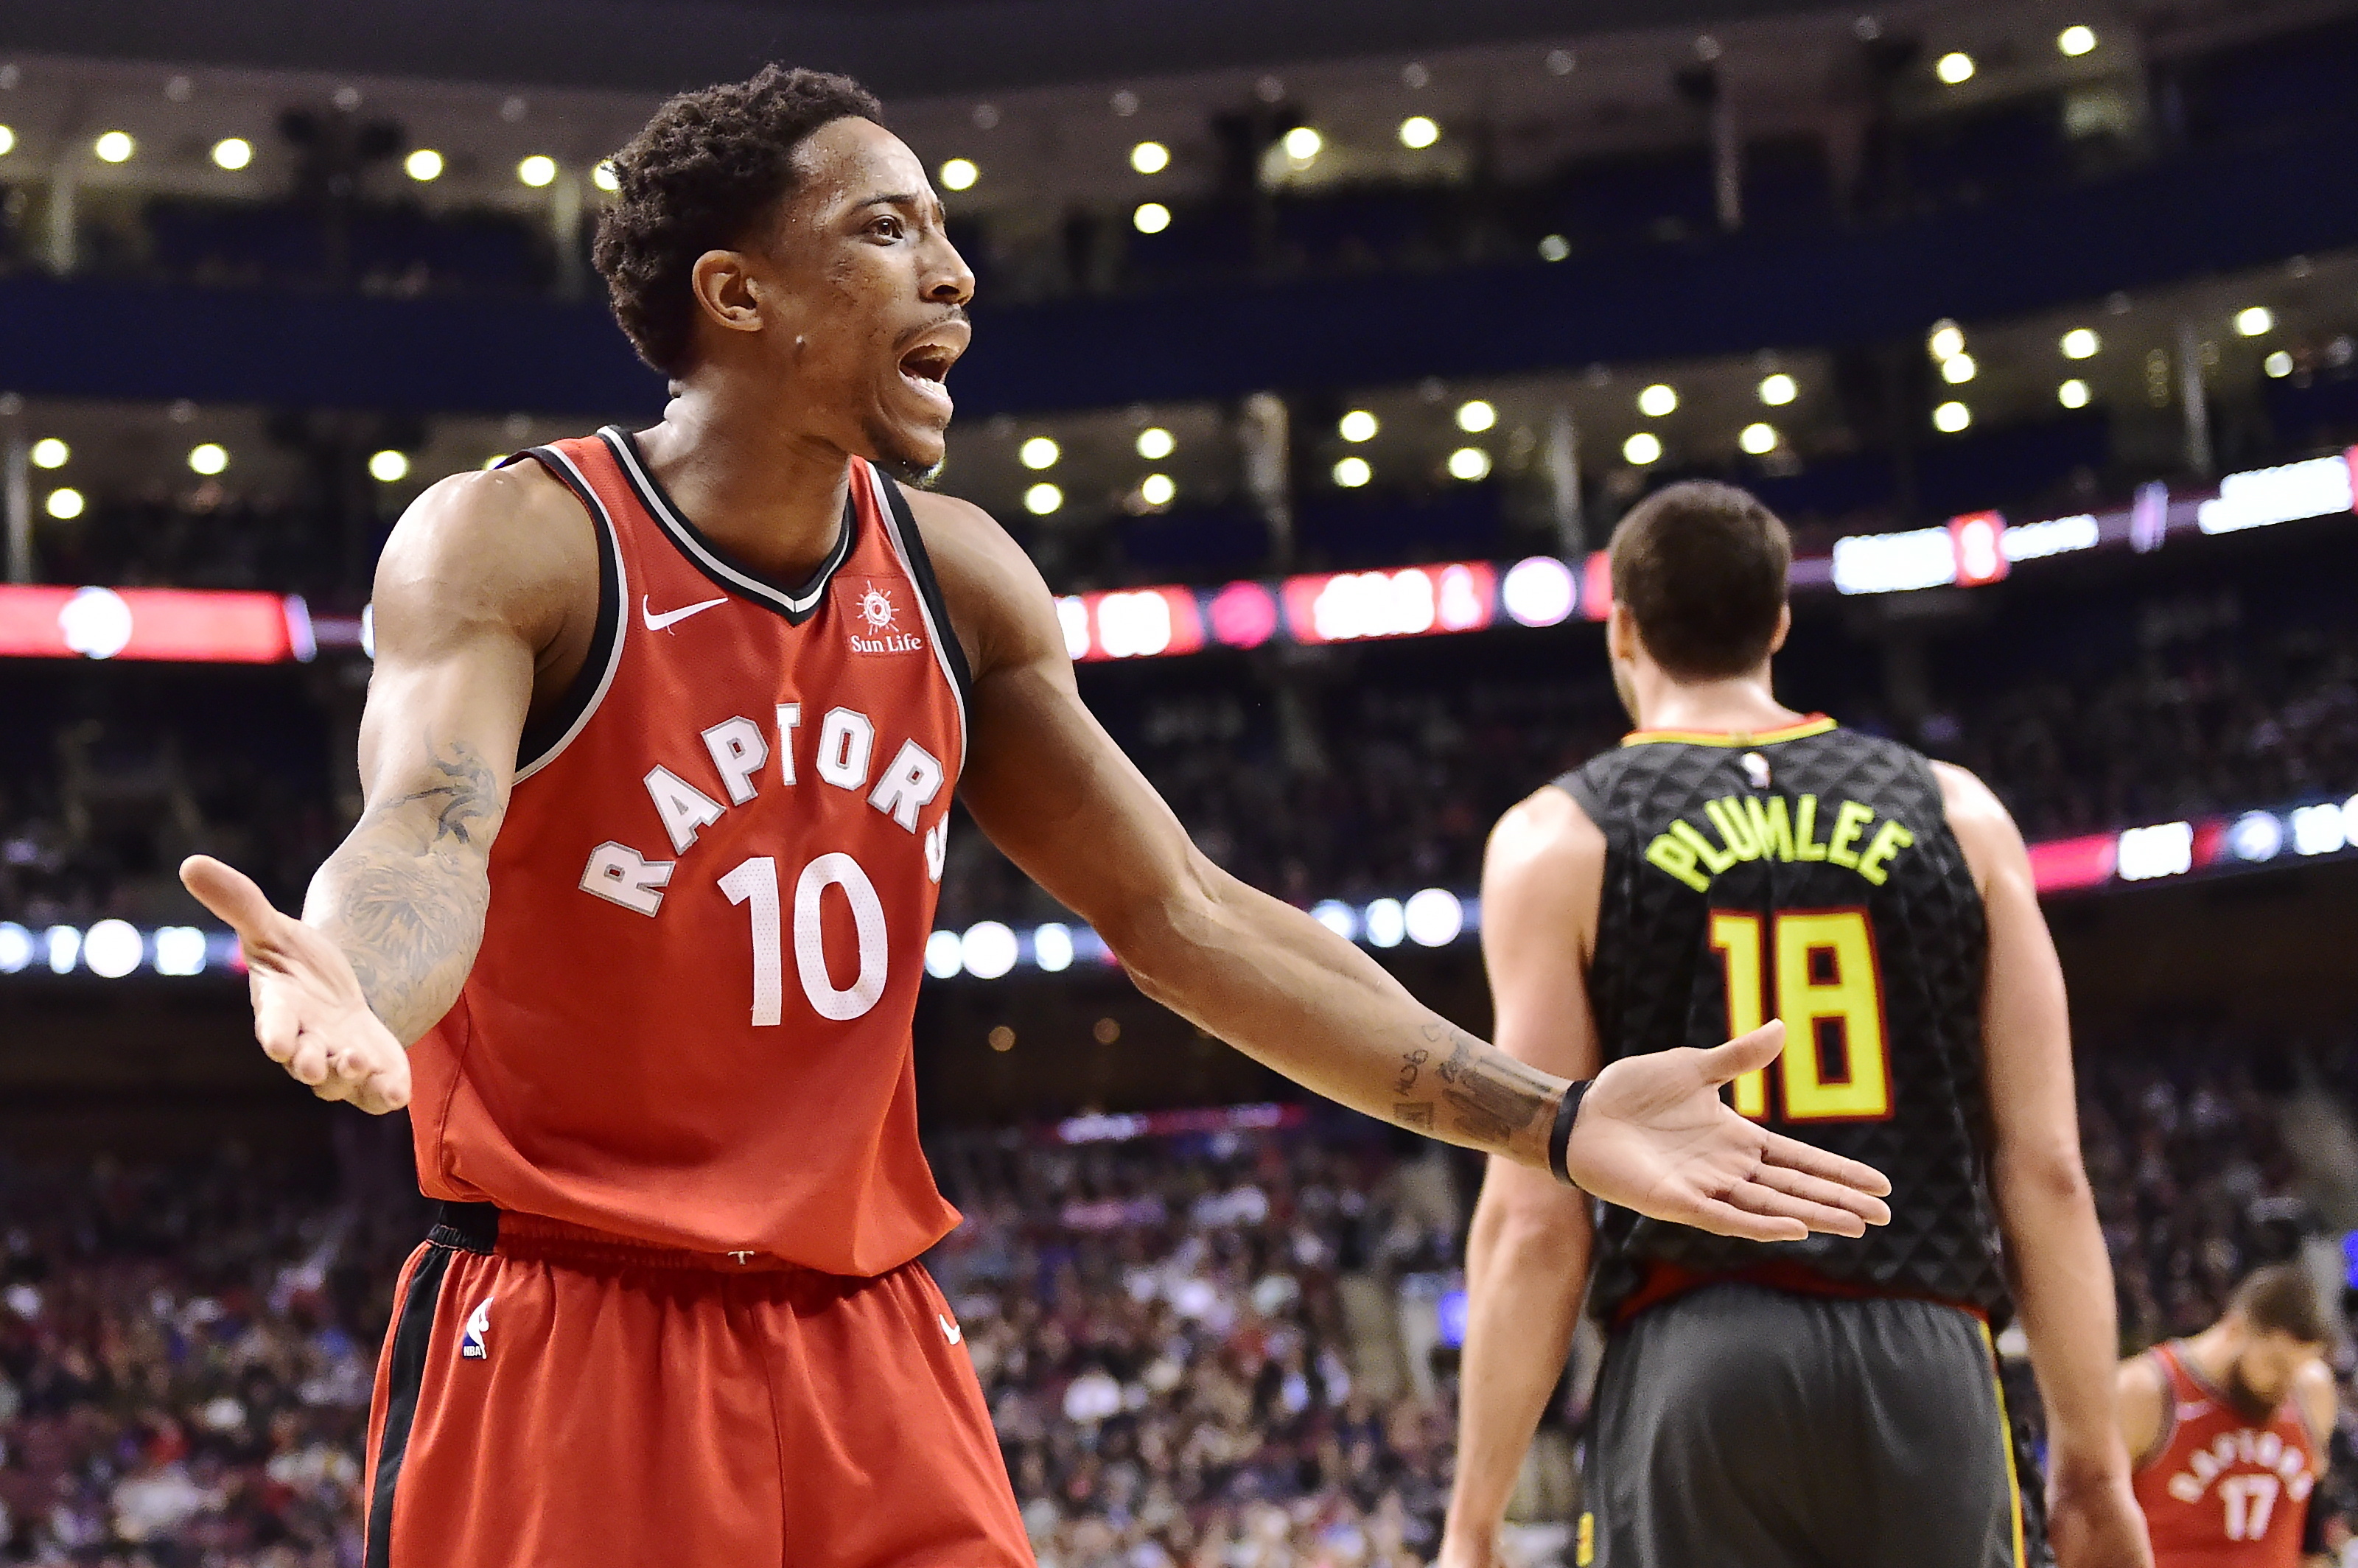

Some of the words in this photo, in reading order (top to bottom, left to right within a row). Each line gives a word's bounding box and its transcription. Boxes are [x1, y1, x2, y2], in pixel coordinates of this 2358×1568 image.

[850, 634, 884, 653] Sun
[886, 632, 923, 652] Life
[1645, 793, 1914, 894] PLUMLEE
[716, 852, 889, 1026] 10
[1707, 906, 1895, 1124] 18
[463, 1345, 481, 1356] NBA
[2217, 1474, 2280, 1541] 17
